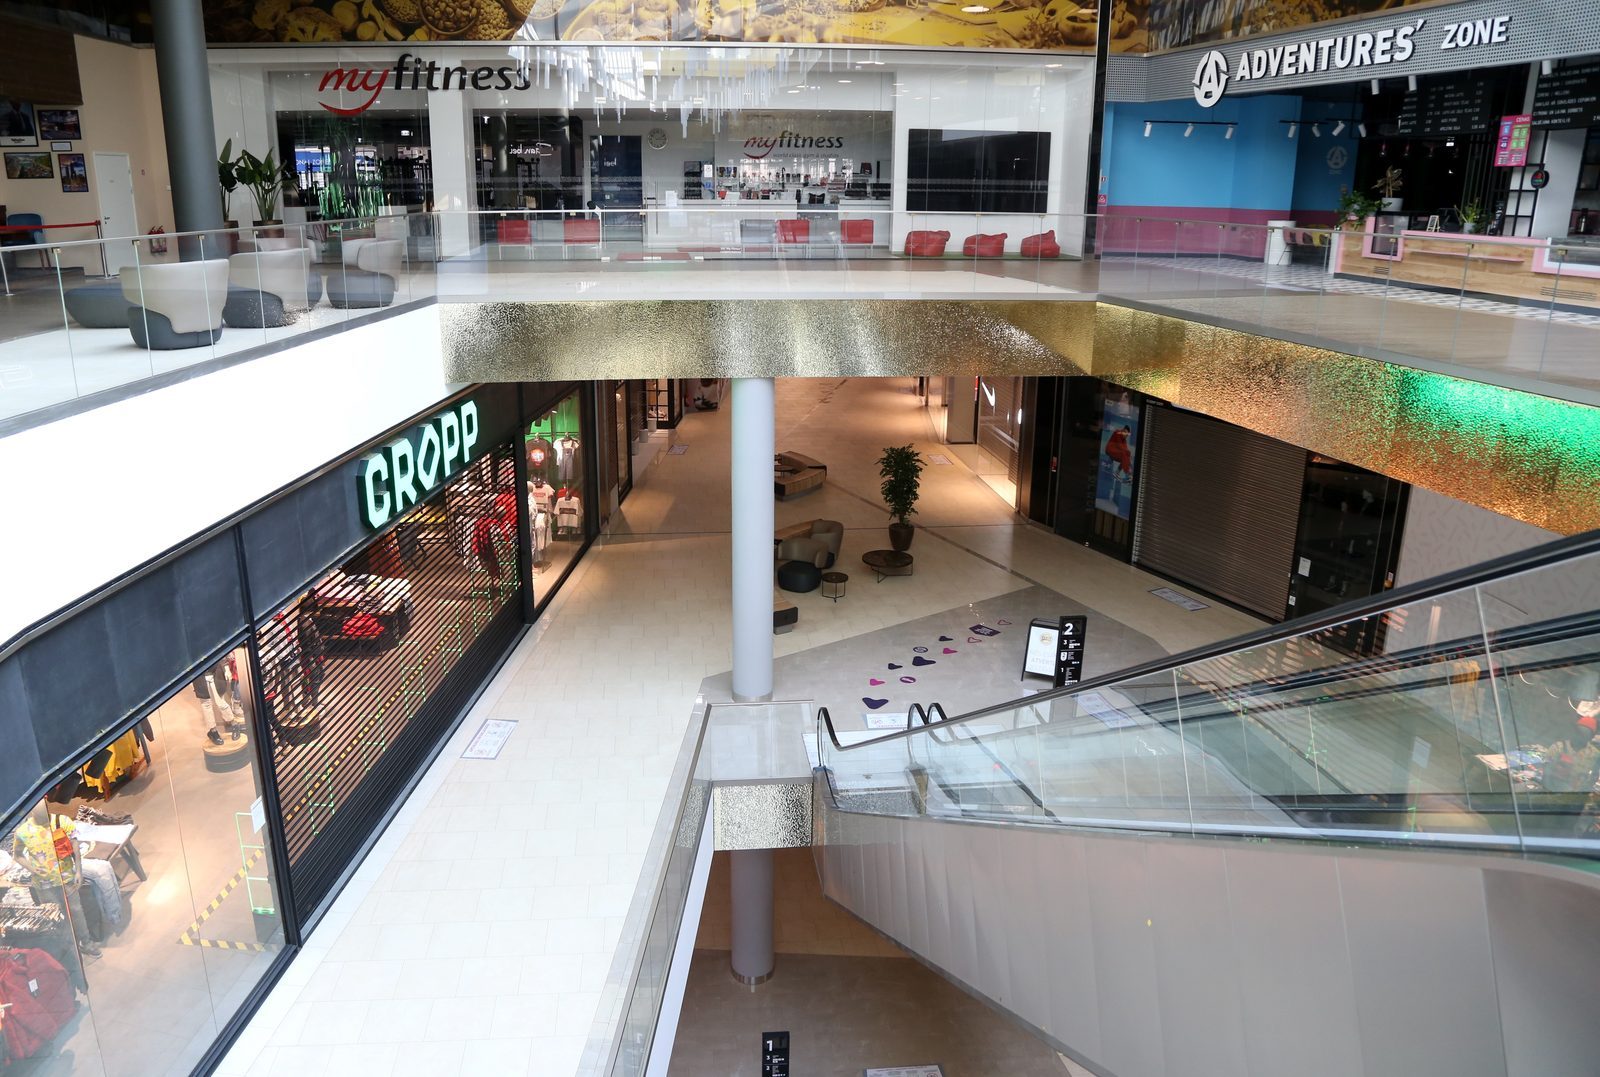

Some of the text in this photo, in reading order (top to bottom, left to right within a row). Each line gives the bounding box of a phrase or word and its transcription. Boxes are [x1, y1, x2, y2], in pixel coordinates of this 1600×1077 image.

[1441, 15, 1511, 50] ZONE
[318, 53, 532, 116] myfitness
[743, 130, 844, 159] myfitness
[364, 400, 479, 529] CROPP
[1064, 623, 1074, 635] 2
[766, 1040, 772, 1052] 1
